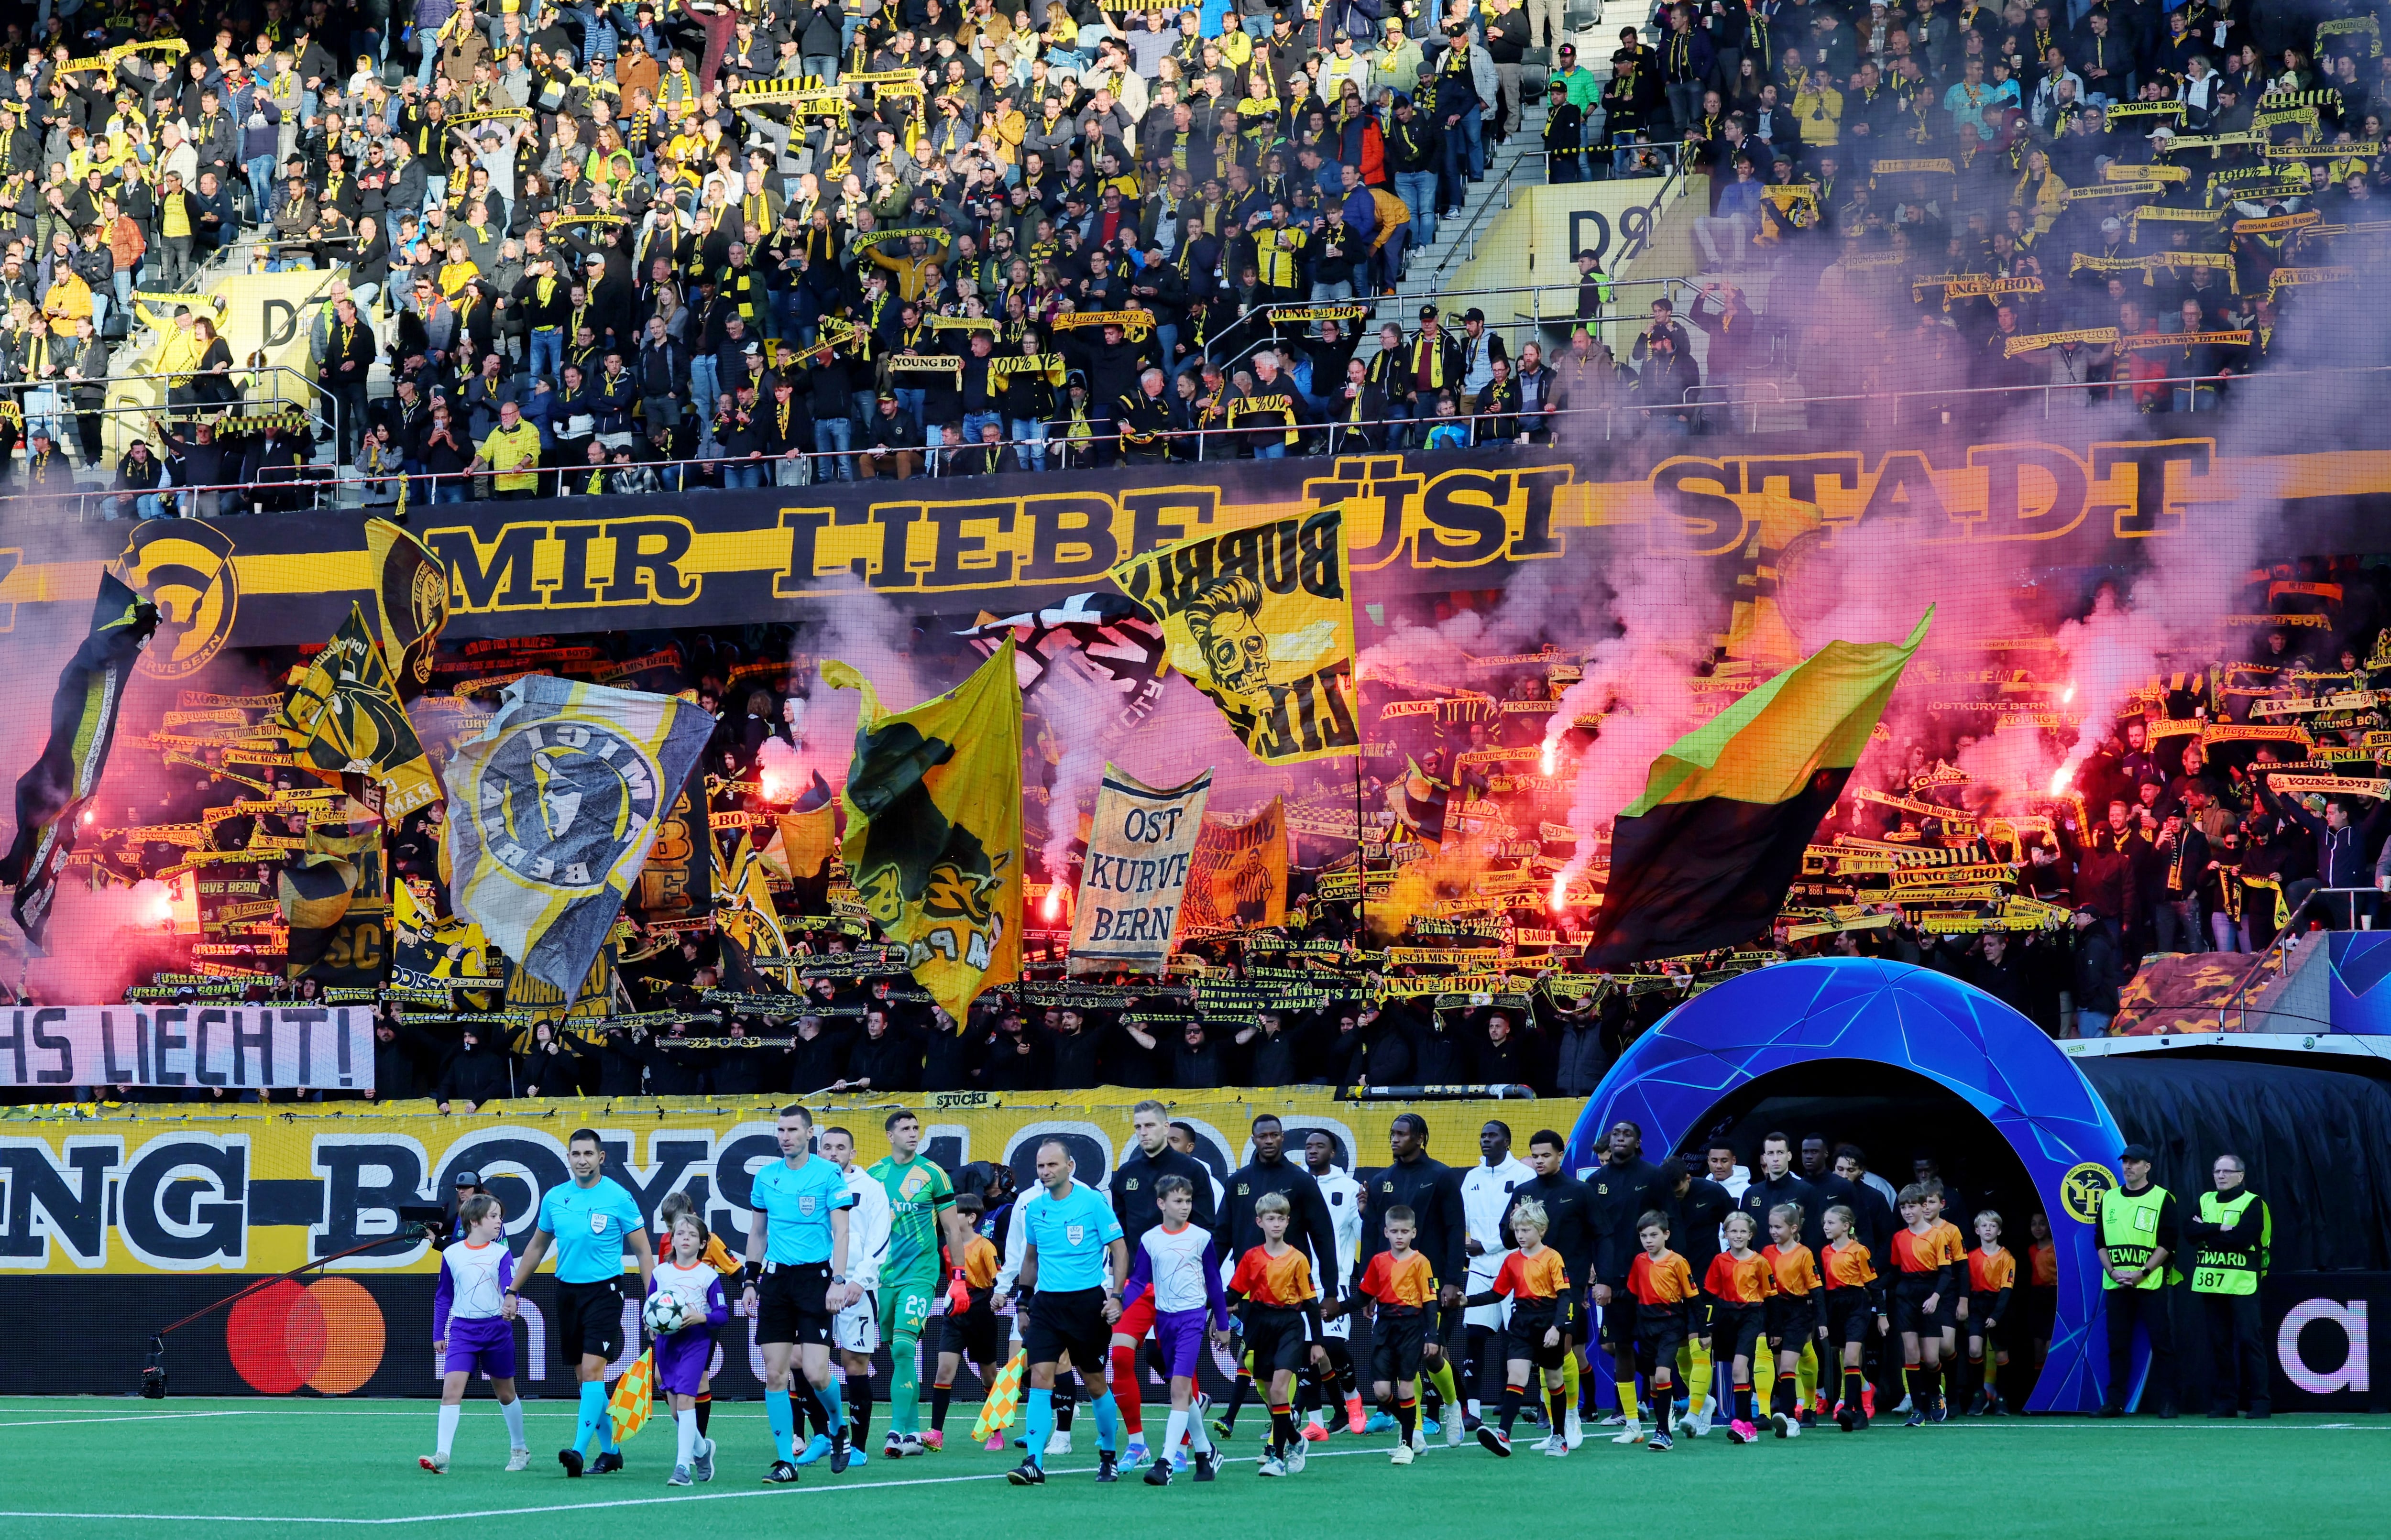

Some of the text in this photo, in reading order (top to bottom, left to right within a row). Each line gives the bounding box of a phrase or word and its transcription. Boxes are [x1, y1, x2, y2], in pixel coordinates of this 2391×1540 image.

[2123, 104, 2158, 113] YOUNG
[2233, 190, 2267, 199] YOUNG
[865, 229, 936, 241] YOUNG BOYS
[183, 292, 208, 301] EVER
[1065, 312, 1104, 325] Young
[895, 358, 938, 367] YOUNG
[425, 516, 701, 614] MIR
[771, 485, 1222, 599] LIEBE
[1649, 436, 2216, 562] STADT
[2310, 717, 2352, 730] YOUNG
[2332, 750, 2361, 760] ISCH
[2288, 777, 2370, 788] YOUNG BOYS
[1883, 793, 1974, 819] BSC Young Boys 189
[1125, 808, 1183, 843] OST
[1811, 846, 1882, 858] YOUNG BOYS
[1089, 906, 1173, 941] BERN
[1398, 953, 1448, 963] ISCH MIS
[160, 974, 274, 986] URBAN SQUAD
[132, 984, 241, 997] URBAN SQUAD
[1209, 1000, 1265, 1009] BURRI'S
[101, 1003, 354, 1088] LIECHT!
[2099, 1167, 2113, 1180] BOYS
[2197, 1272, 2225, 1287] 387
[905, 1295, 927, 1317] 23
[1568, 1302, 1573, 1321] 4
[1705, 1305, 1712, 1322] 7
[859, 1317, 868, 1337] 7
